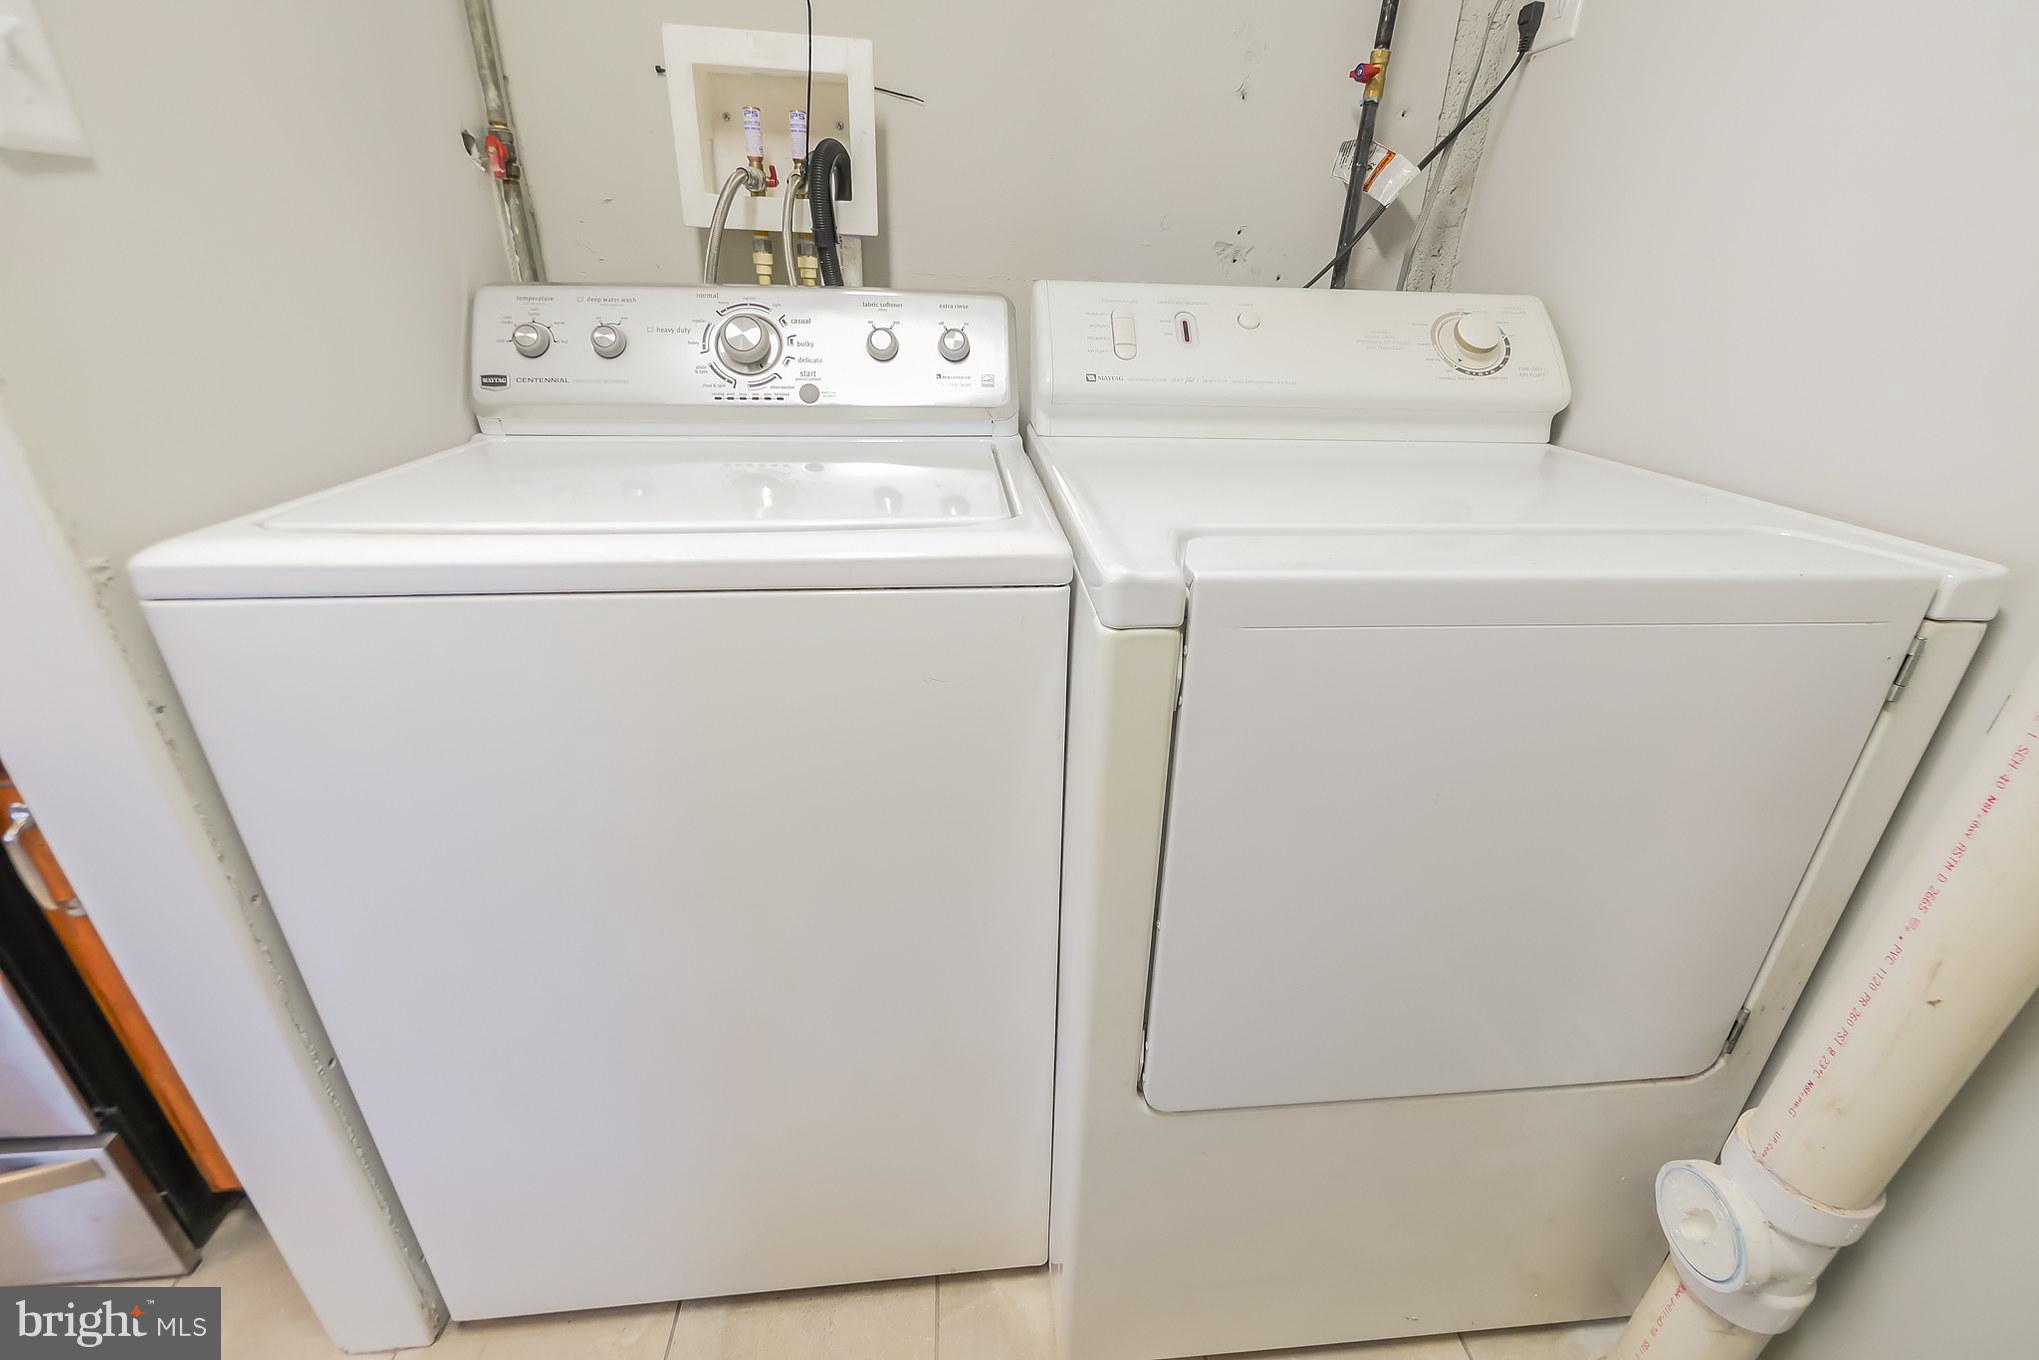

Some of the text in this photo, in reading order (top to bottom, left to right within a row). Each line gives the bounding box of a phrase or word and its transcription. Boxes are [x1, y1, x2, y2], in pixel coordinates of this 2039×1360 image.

[516, 295, 554, 303] temperature
[586, 296, 602, 304] deep
[790, 317, 811, 325] casual
[515, 376, 569, 384] CENTENNIAL
[2008, 744, 2029, 770] SCH
[1995, 773, 2011, 790] 40
[1944, 841, 1967, 872] ASTM
[1937, 872, 1948, 883] D
[1918, 885, 1940, 913] 2665
[1885, 943, 1904, 966] PVC
[1869, 967, 1888, 992] 1120
[1858, 991, 1872, 1008] PR
[1847, 1006, 1862, 1028] 260
[1834, 1027, 1850, 1047] PSI
